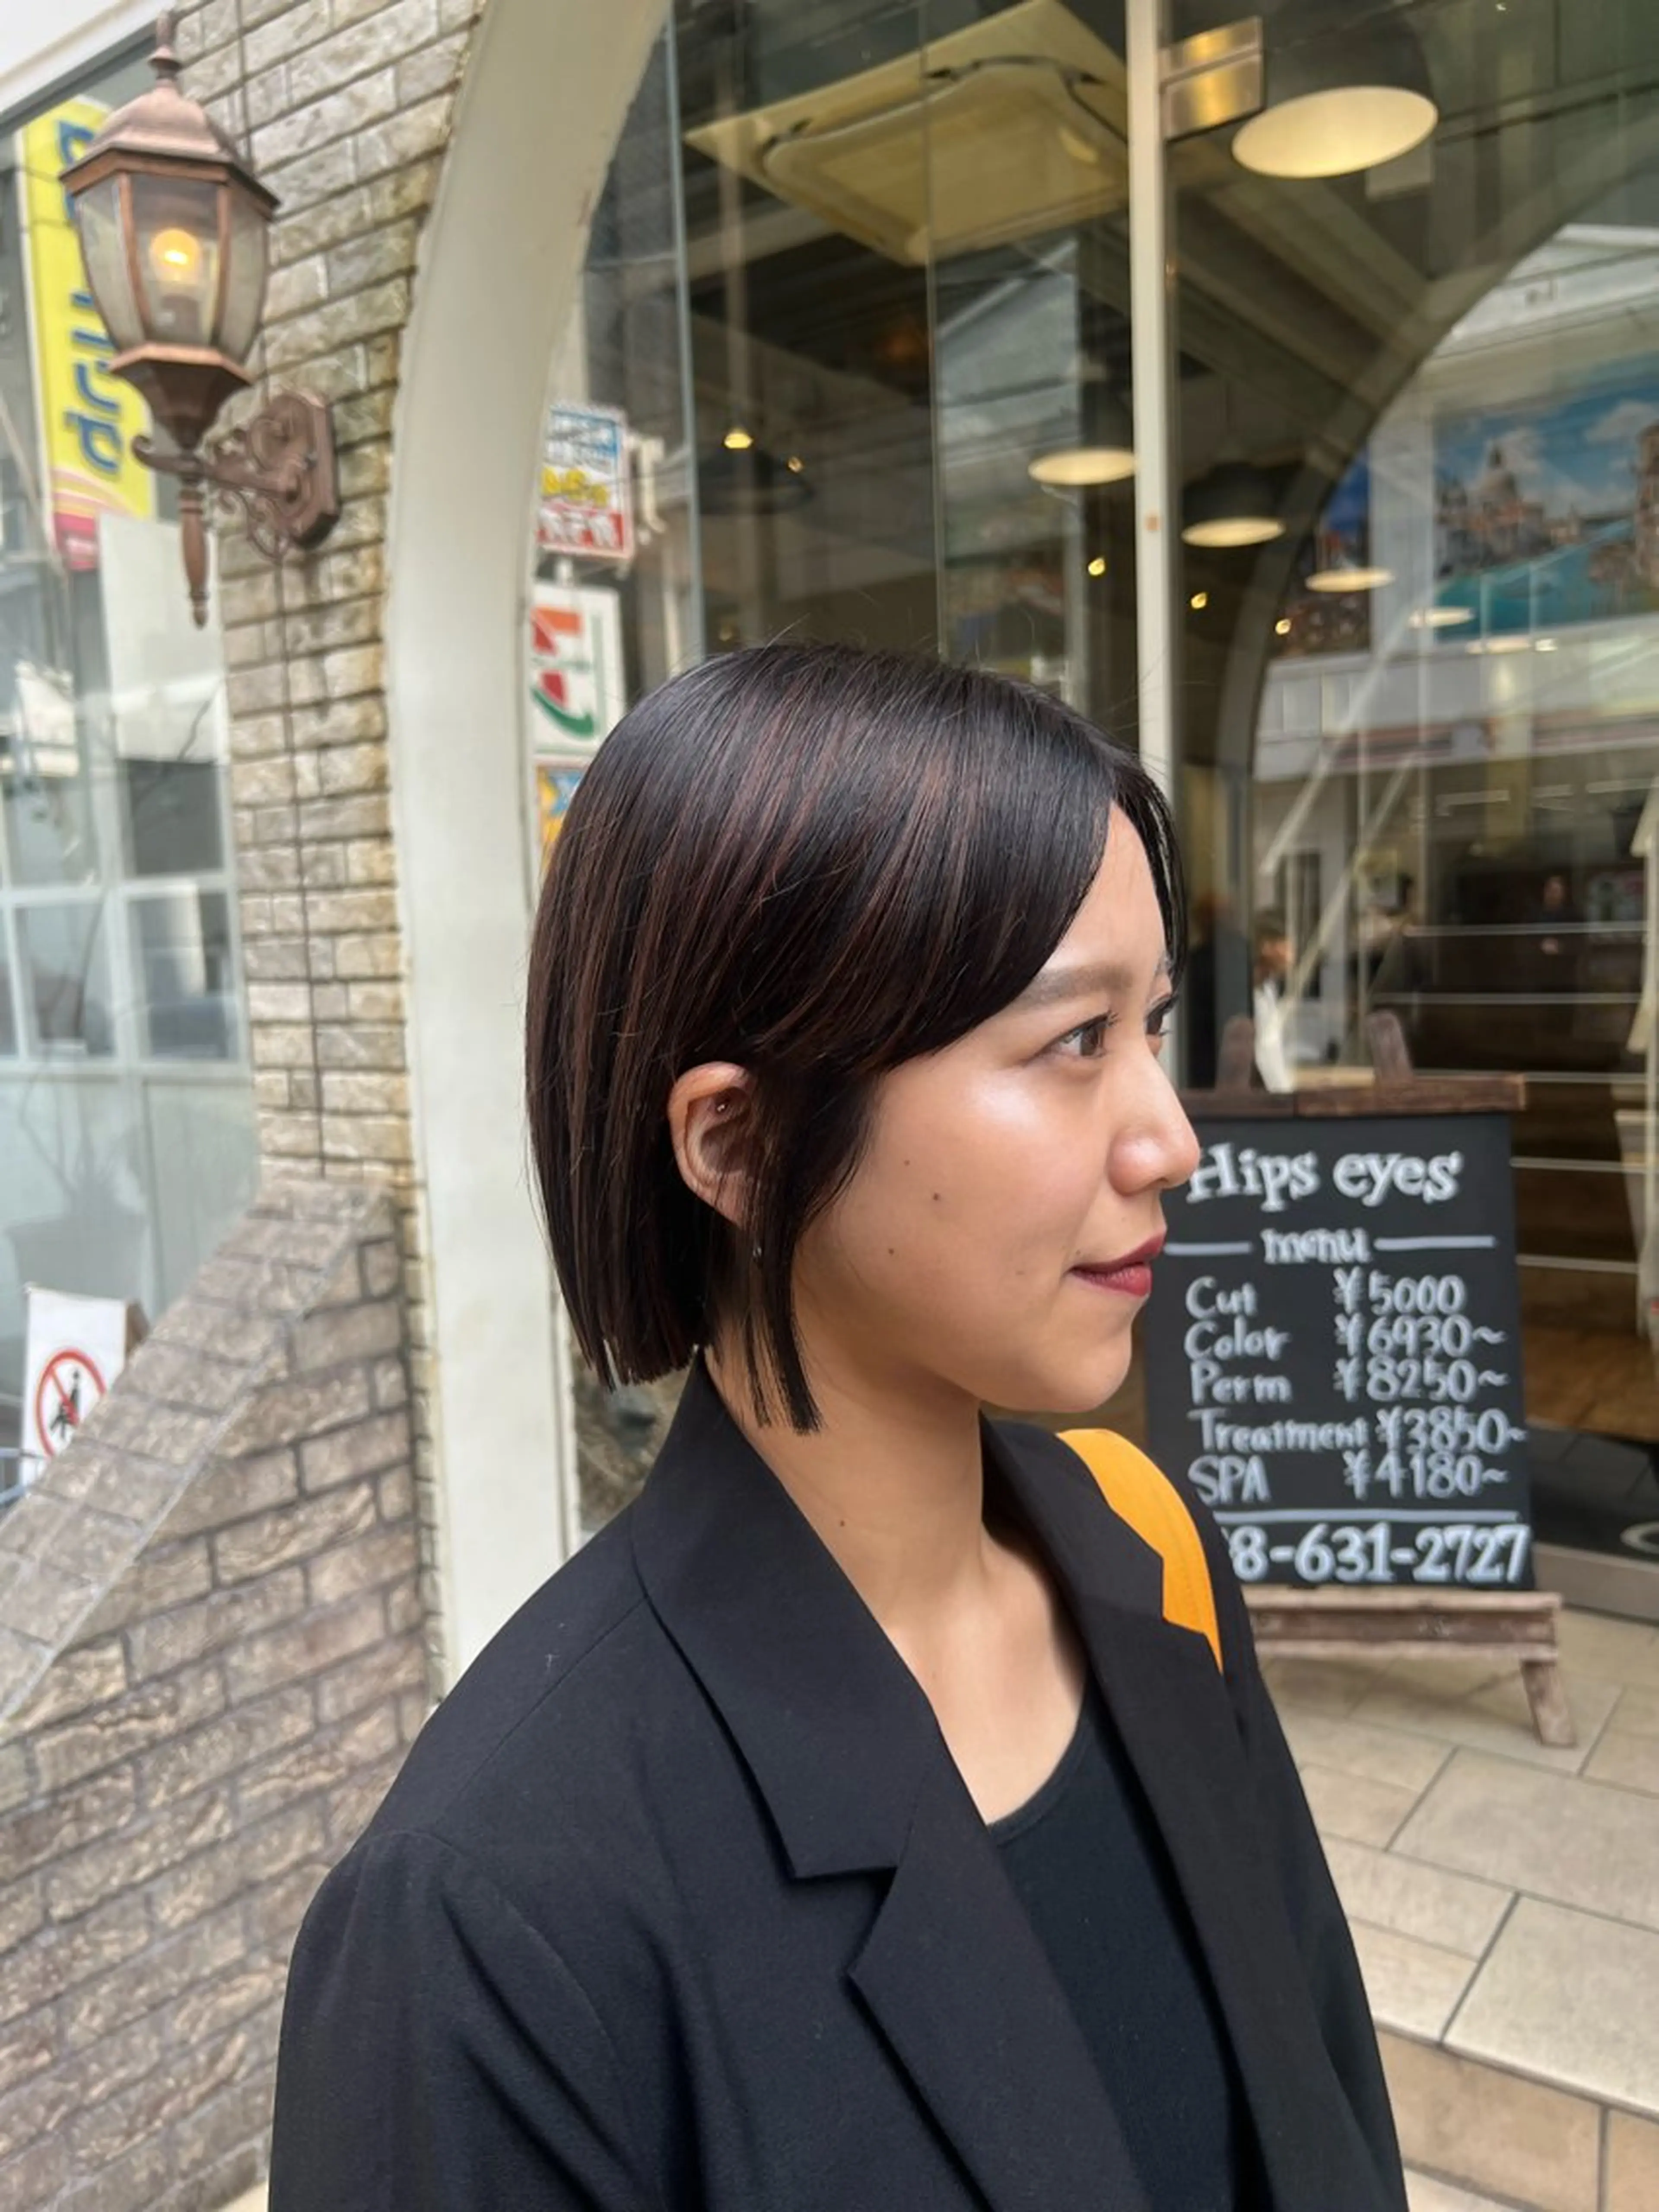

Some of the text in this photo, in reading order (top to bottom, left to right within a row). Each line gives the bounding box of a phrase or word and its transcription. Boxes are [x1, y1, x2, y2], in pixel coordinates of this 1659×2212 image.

[1333, 1150, 1464, 1207] eyes
[1260, 1227, 1372, 1264] menu
[1185, 1266, 1466, 1319] Cut ¥5000
[1184, 1315, 1292, 1362] Color
[1190, 1359, 1293, 1405] Perm
[1186, 1407, 1370, 1453] Treatment
[1187, 1454, 1271, 1505] SPA
[1221, 1520, 1533, 1583] 8-631-2727
